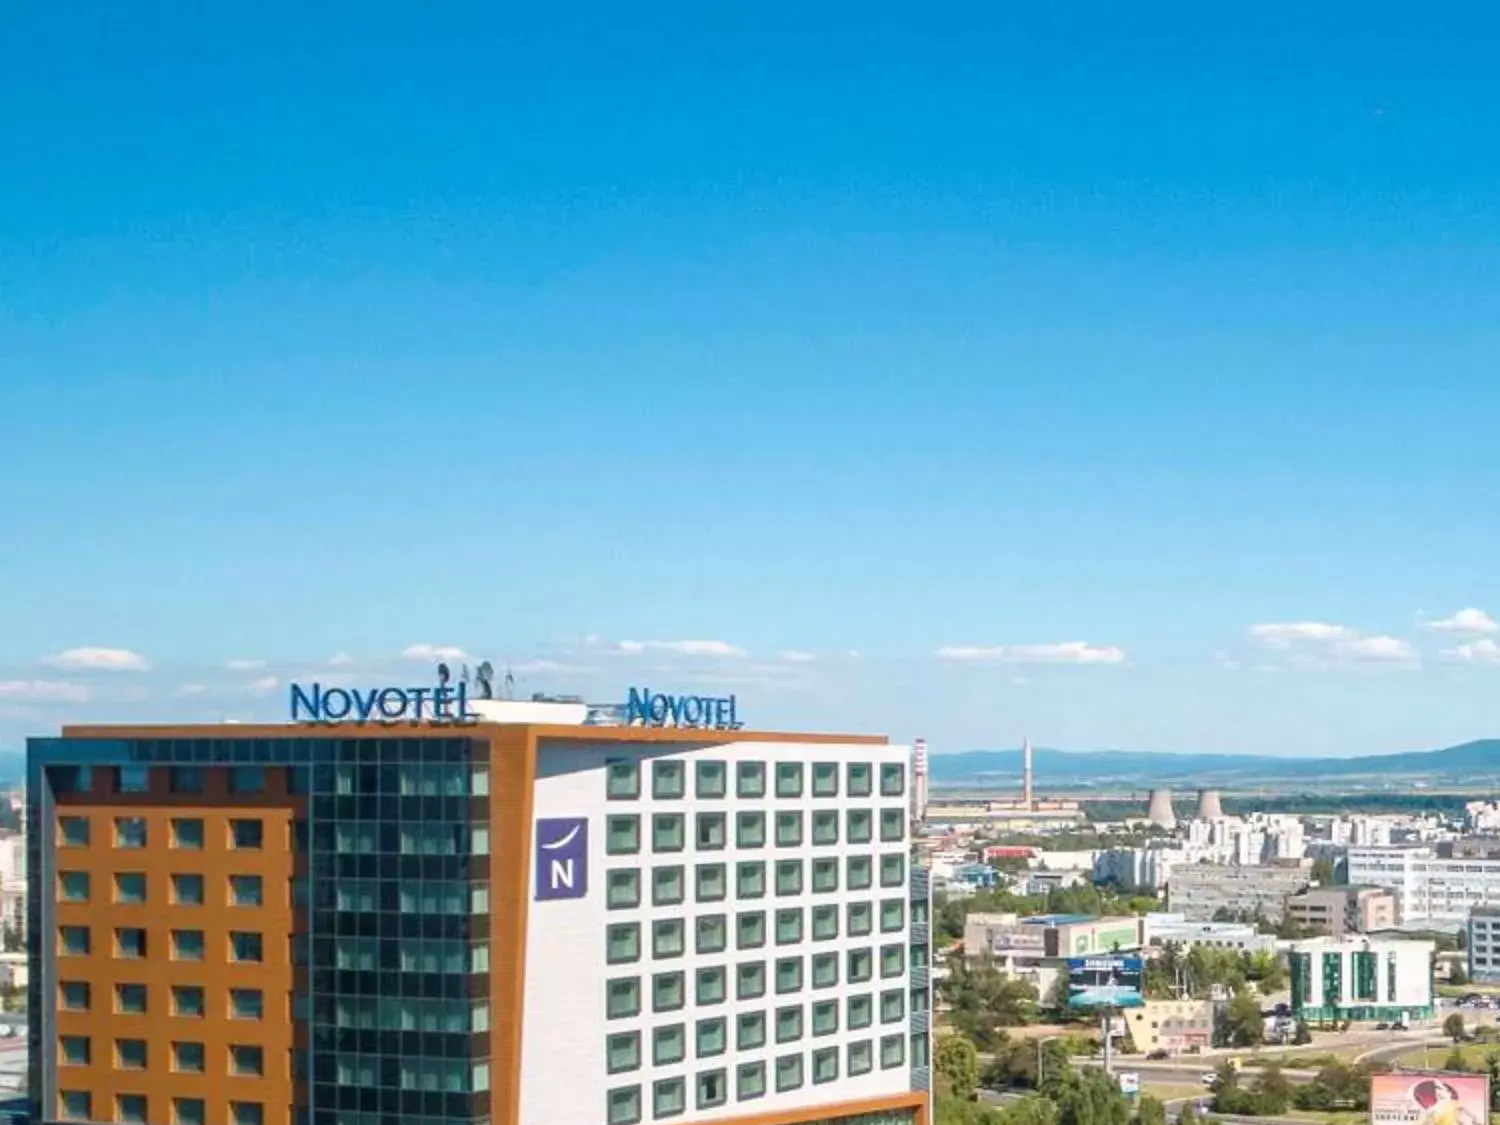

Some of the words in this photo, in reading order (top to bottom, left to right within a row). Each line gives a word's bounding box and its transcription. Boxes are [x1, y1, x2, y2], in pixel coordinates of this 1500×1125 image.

[290, 682, 481, 721] NOVOTEL
[627, 687, 745, 727] NOVOTEL
[551, 859, 574, 889] N
